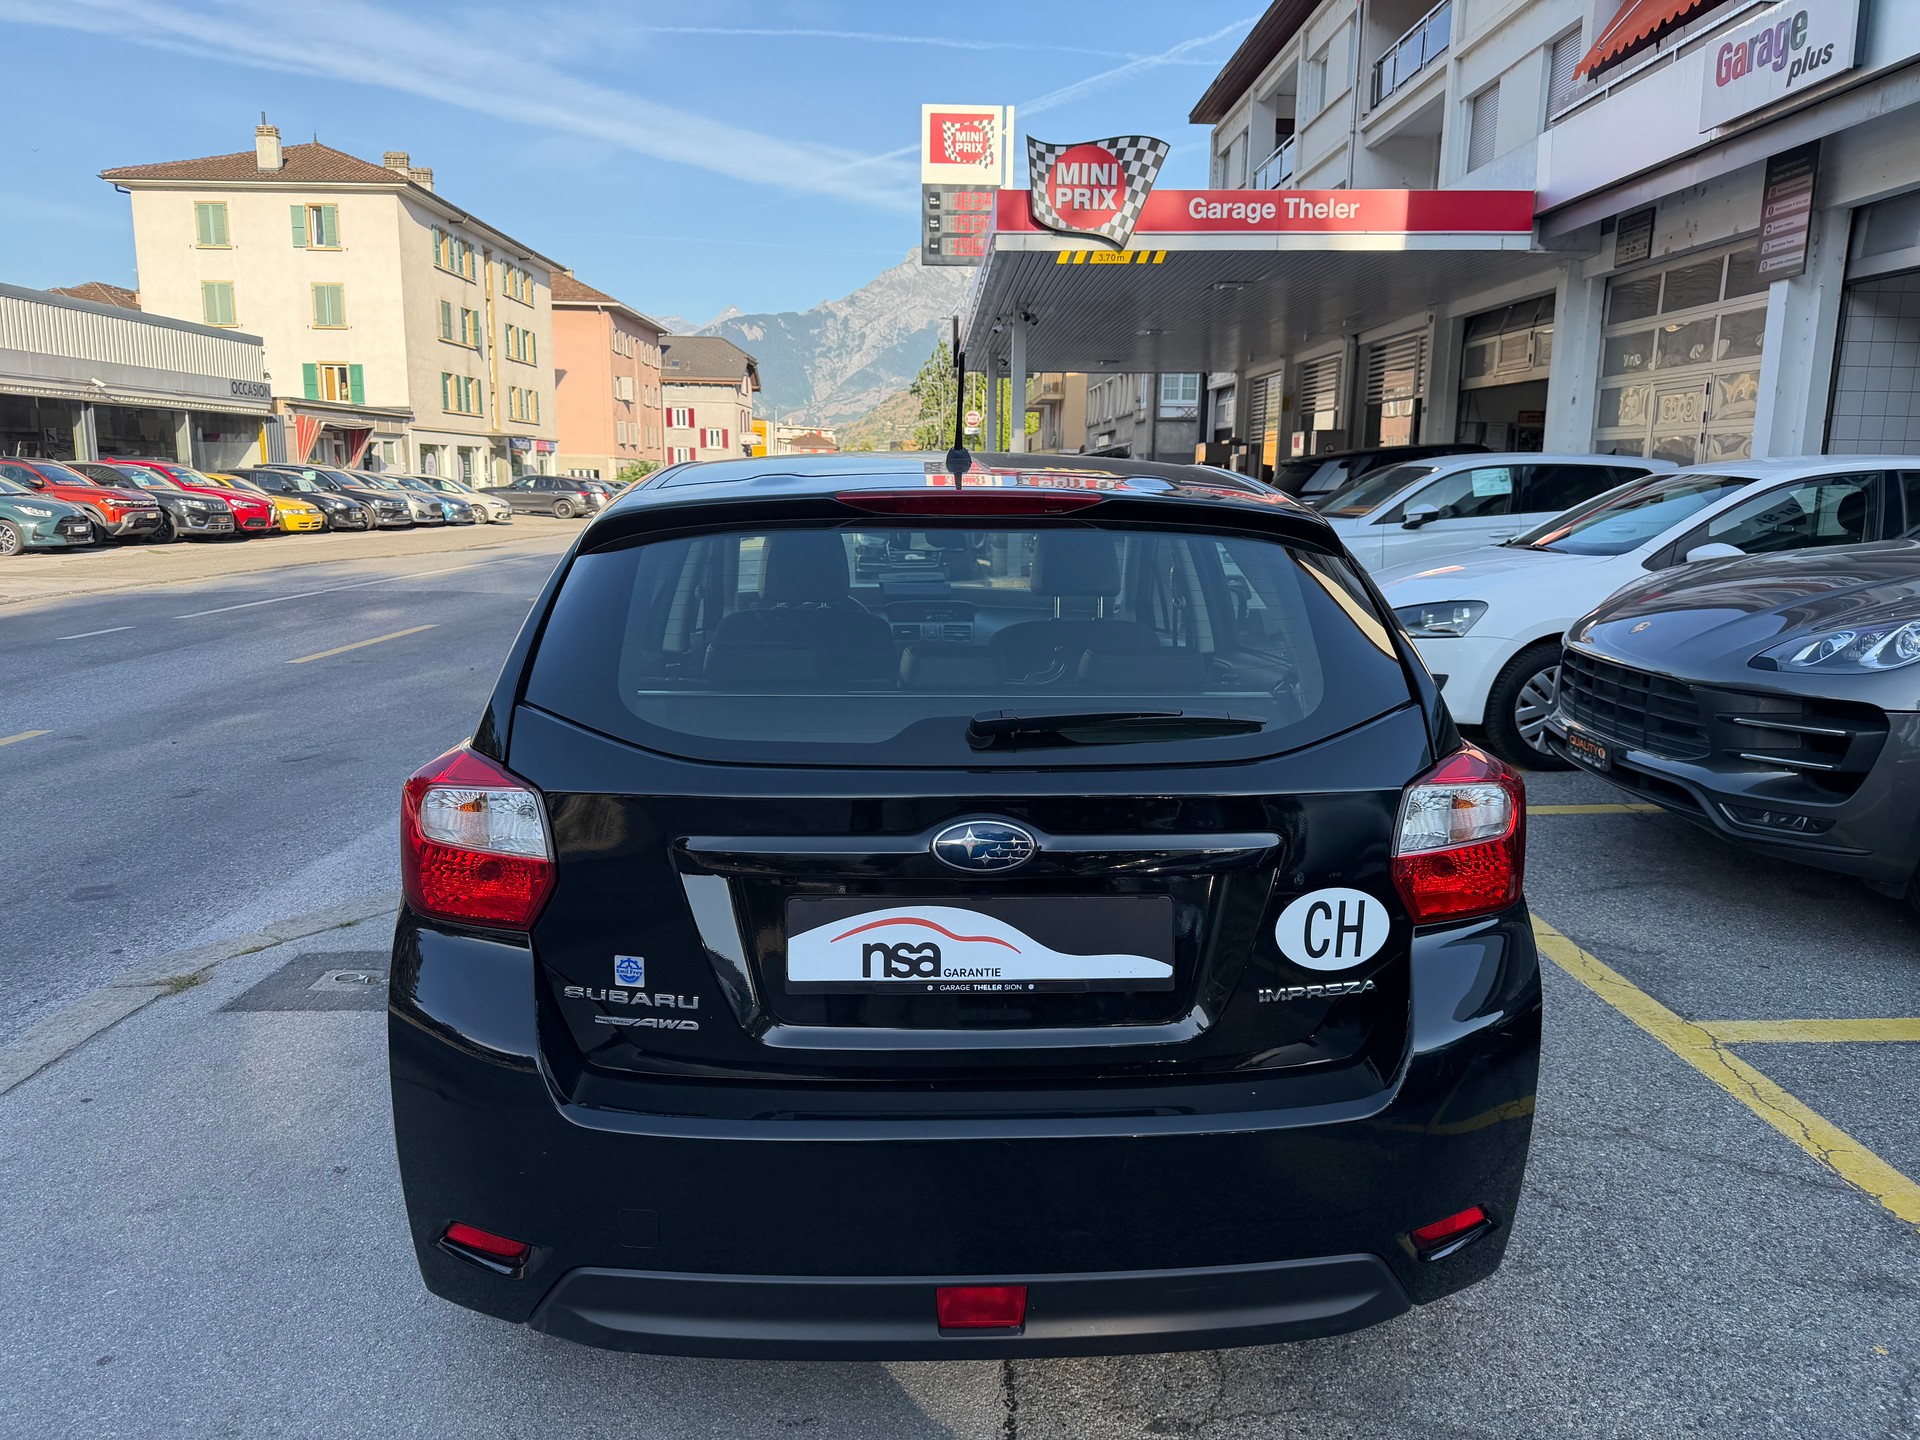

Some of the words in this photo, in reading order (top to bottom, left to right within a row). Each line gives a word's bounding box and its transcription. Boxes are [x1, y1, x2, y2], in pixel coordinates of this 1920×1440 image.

[1715, 9, 1809, 88] Garage
[1786, 42, 1835, 89] plus
[955, 130, 984, 143] MINI
[955, 142, 984, 154] PRIX
[1056, 162, 1118, 185] MINI
[1055, 188, 1118, 210] PRIX
[1188, 197, 1276, 224] Garage
[1284, 197, 1360, 220] Theler
[1304, 900, 1366, 959] CH
[862, 942, 941, 978] nsa
[943, 967, 1002, 978] GARANTIE
[629, 969, 643, 977] Frey
[564, 985, 699, 1010] SUBARU
[1258, 978, 1378, 1003] IMPREZA
[633, 1017, 699, 1031] AWD
